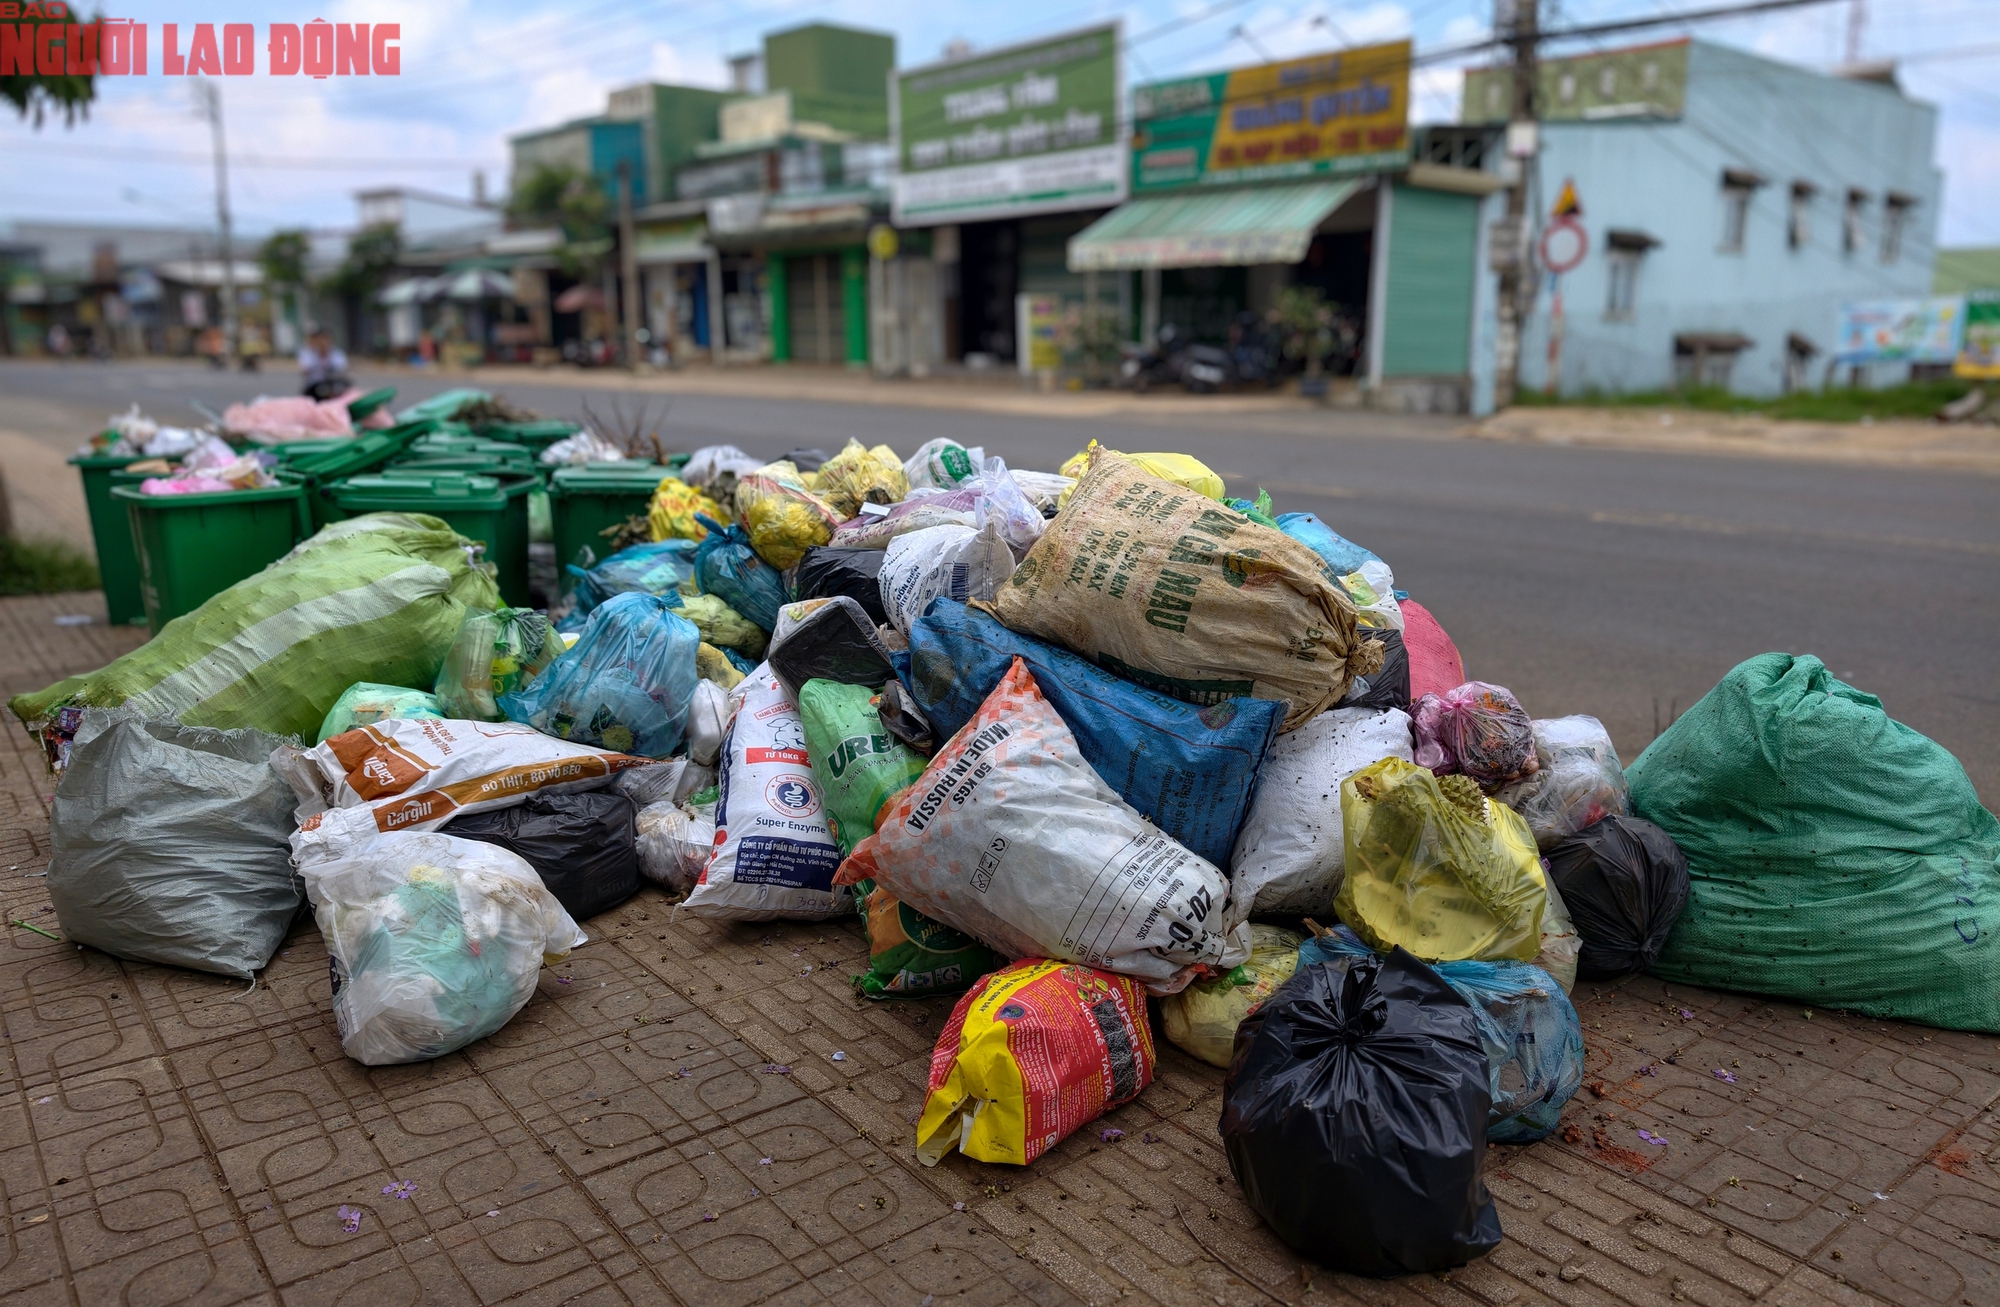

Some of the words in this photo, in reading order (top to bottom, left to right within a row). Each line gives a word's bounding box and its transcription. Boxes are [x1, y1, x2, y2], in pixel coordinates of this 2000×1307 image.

[1087, 562, 1111, 592] MAX
[1108, 572, 1130, 599] MIN
[1145, 569, 1202, 634] MAU
[778, 752, 799, 760] 10KG
[828, 733, 901, 779] URE
[965, 723, 1010, 760] MADE
[363, 756, 396, 786] Cargill
[481, 779, 498, 793] BÒ
[530, 768, 546, 783] BÒ
[562, 762, 582, 776] BÉO
[950, 758, 972, 777] IN
[973, 762, 992, 779] 50
[907, 774, 957, 830] RUSSIA
[952, 778, 978, 805] KGS
[387, 801, 433, 827] Cargill
[756, 817, 786, 828] Super
[788, 821, 826, 834] Enzyme
[742, 841, 756, 850] CÔNG
[807, 847, 821, 856] PHÚC
[822, 850, 840, 859] KHANG
[1156, 878, 1184, 909] GUARANTEED
[1135, 906, 1159, 941] ANALYSIS:
[1109, 986, 1136, 1049] SUPER
[1079, 1001, 1099, 1033] KÍCH
[1100, 1057, 1112, 1080] TÁI
